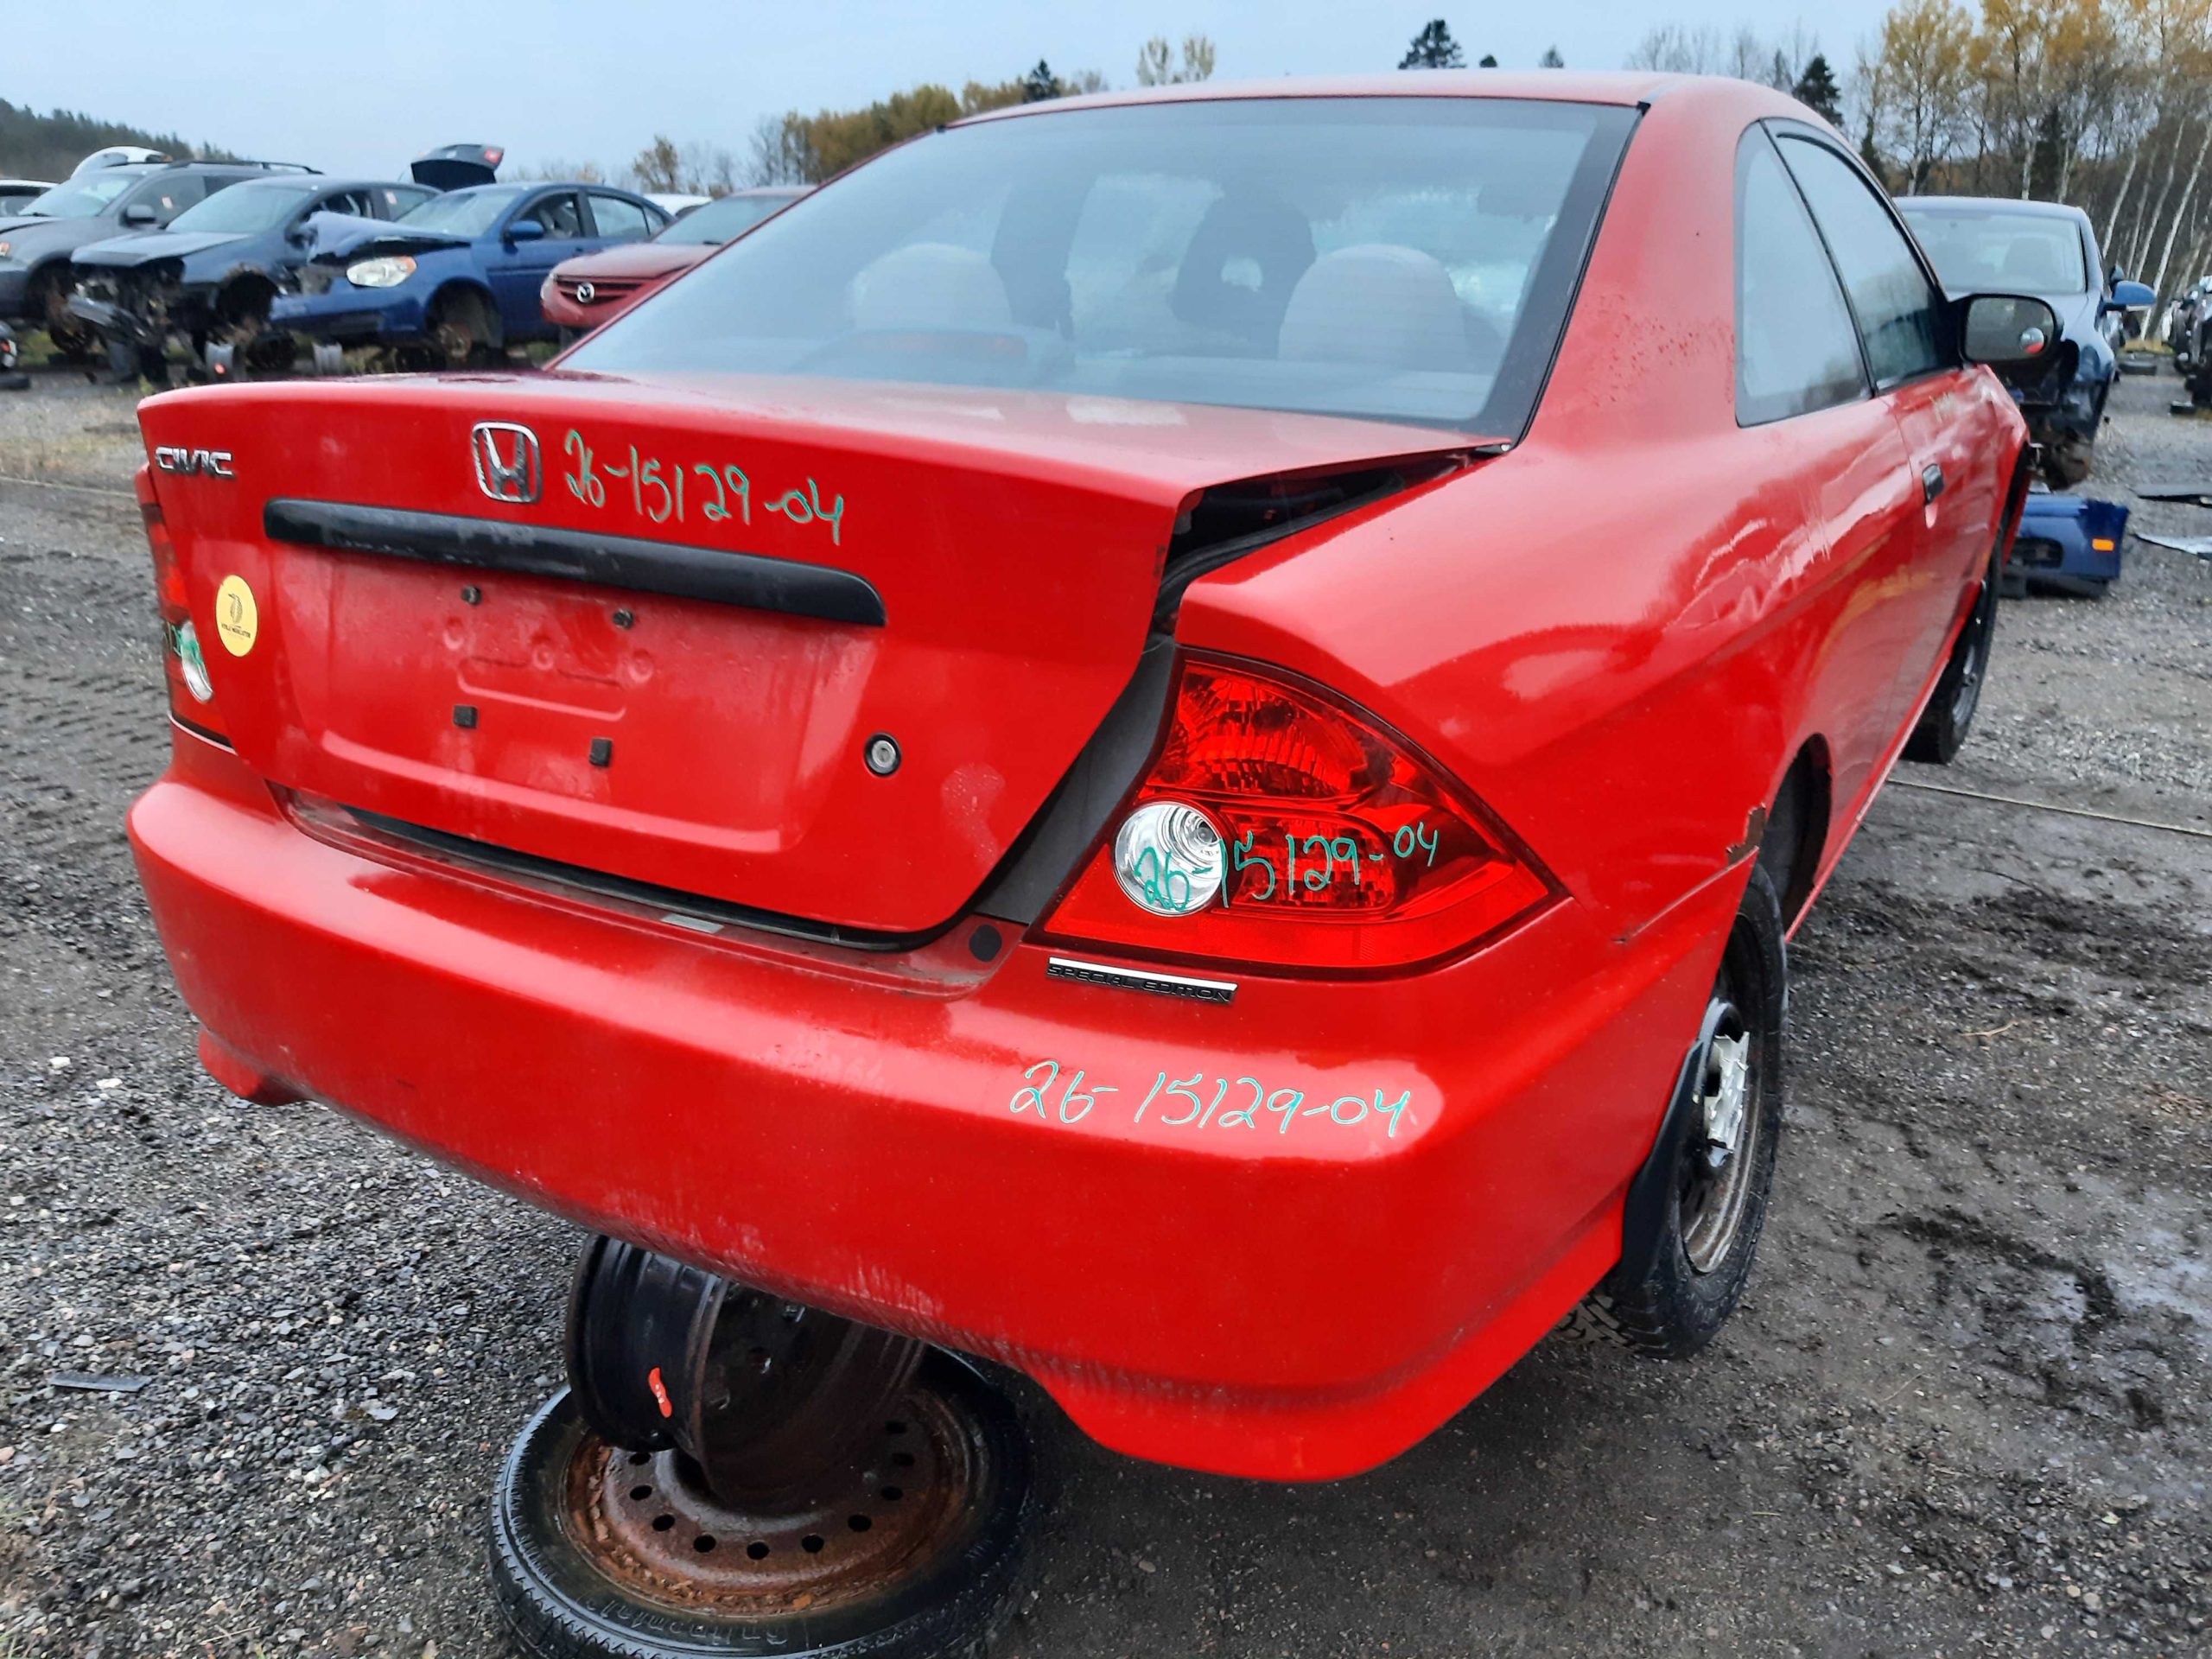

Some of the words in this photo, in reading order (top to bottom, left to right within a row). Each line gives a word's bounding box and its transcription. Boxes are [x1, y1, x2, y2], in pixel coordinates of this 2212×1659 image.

[156, 446, 234, 475] CIVIC
[565, 429, 843, 545] 26-15129-04
[1047, 965, 1134, 988] SPECIAL
